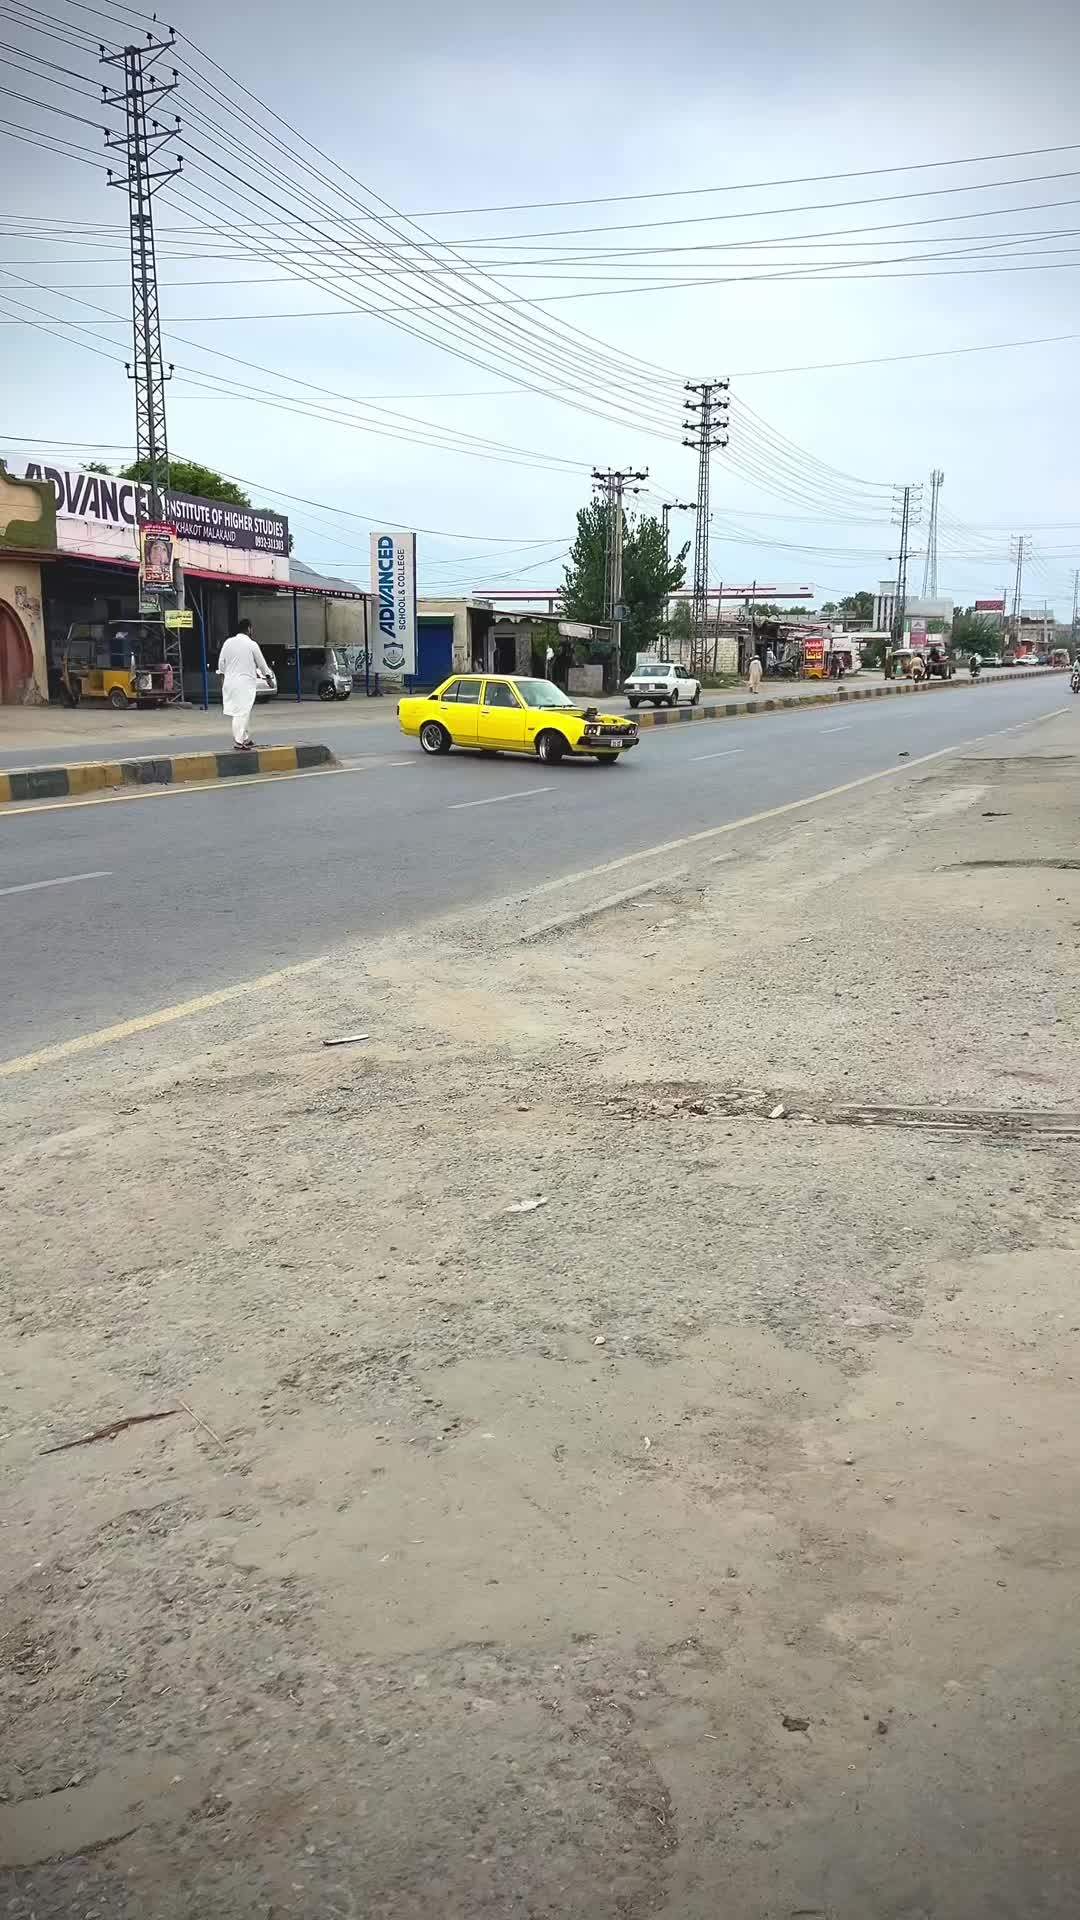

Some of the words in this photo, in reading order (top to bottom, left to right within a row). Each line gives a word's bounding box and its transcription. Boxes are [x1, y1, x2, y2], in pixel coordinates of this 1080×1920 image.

[203, 526, 236, 542] MALAKAND
[211, 508, 223, 525] OF
[224, 511, 253, 532] HIGHER
[254, 517, 283, 537] STUDIES
[397, 549, 406, 588] COLLEGE
[378, 536, 396, 638] ADVANCED
[399, 589, 406, 597] &
[398, 598, 406, 630] SCHOOL
